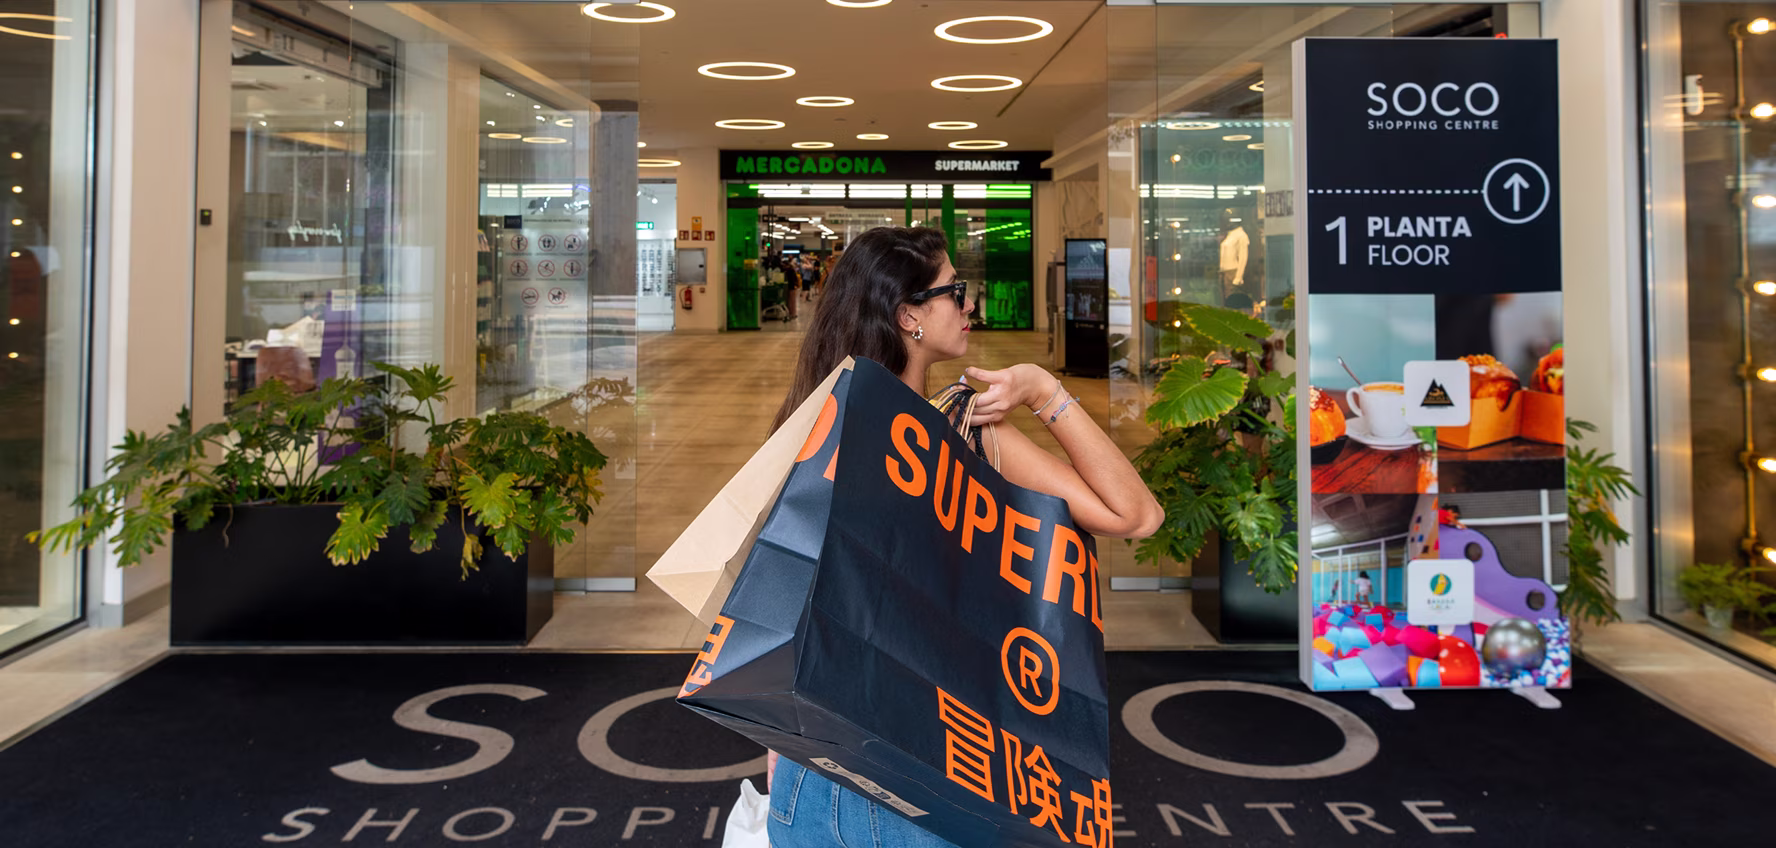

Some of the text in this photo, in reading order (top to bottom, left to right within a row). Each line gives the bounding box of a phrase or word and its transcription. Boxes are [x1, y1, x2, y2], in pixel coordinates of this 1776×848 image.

[1366, 82, 1500, 117] SOCO
[1367, 120, 1500, 131] SHOPPING CENTRE
[736, 156, 1020, 175] MERCADONA SUPERMARKET
[1367, 216, 1473, 238] PLANTA
[1325, 216, 1347, 265] 1
[1368, 244, 1451, 266] FLOOR
[261, 806, 720, 843] SHOPPI
